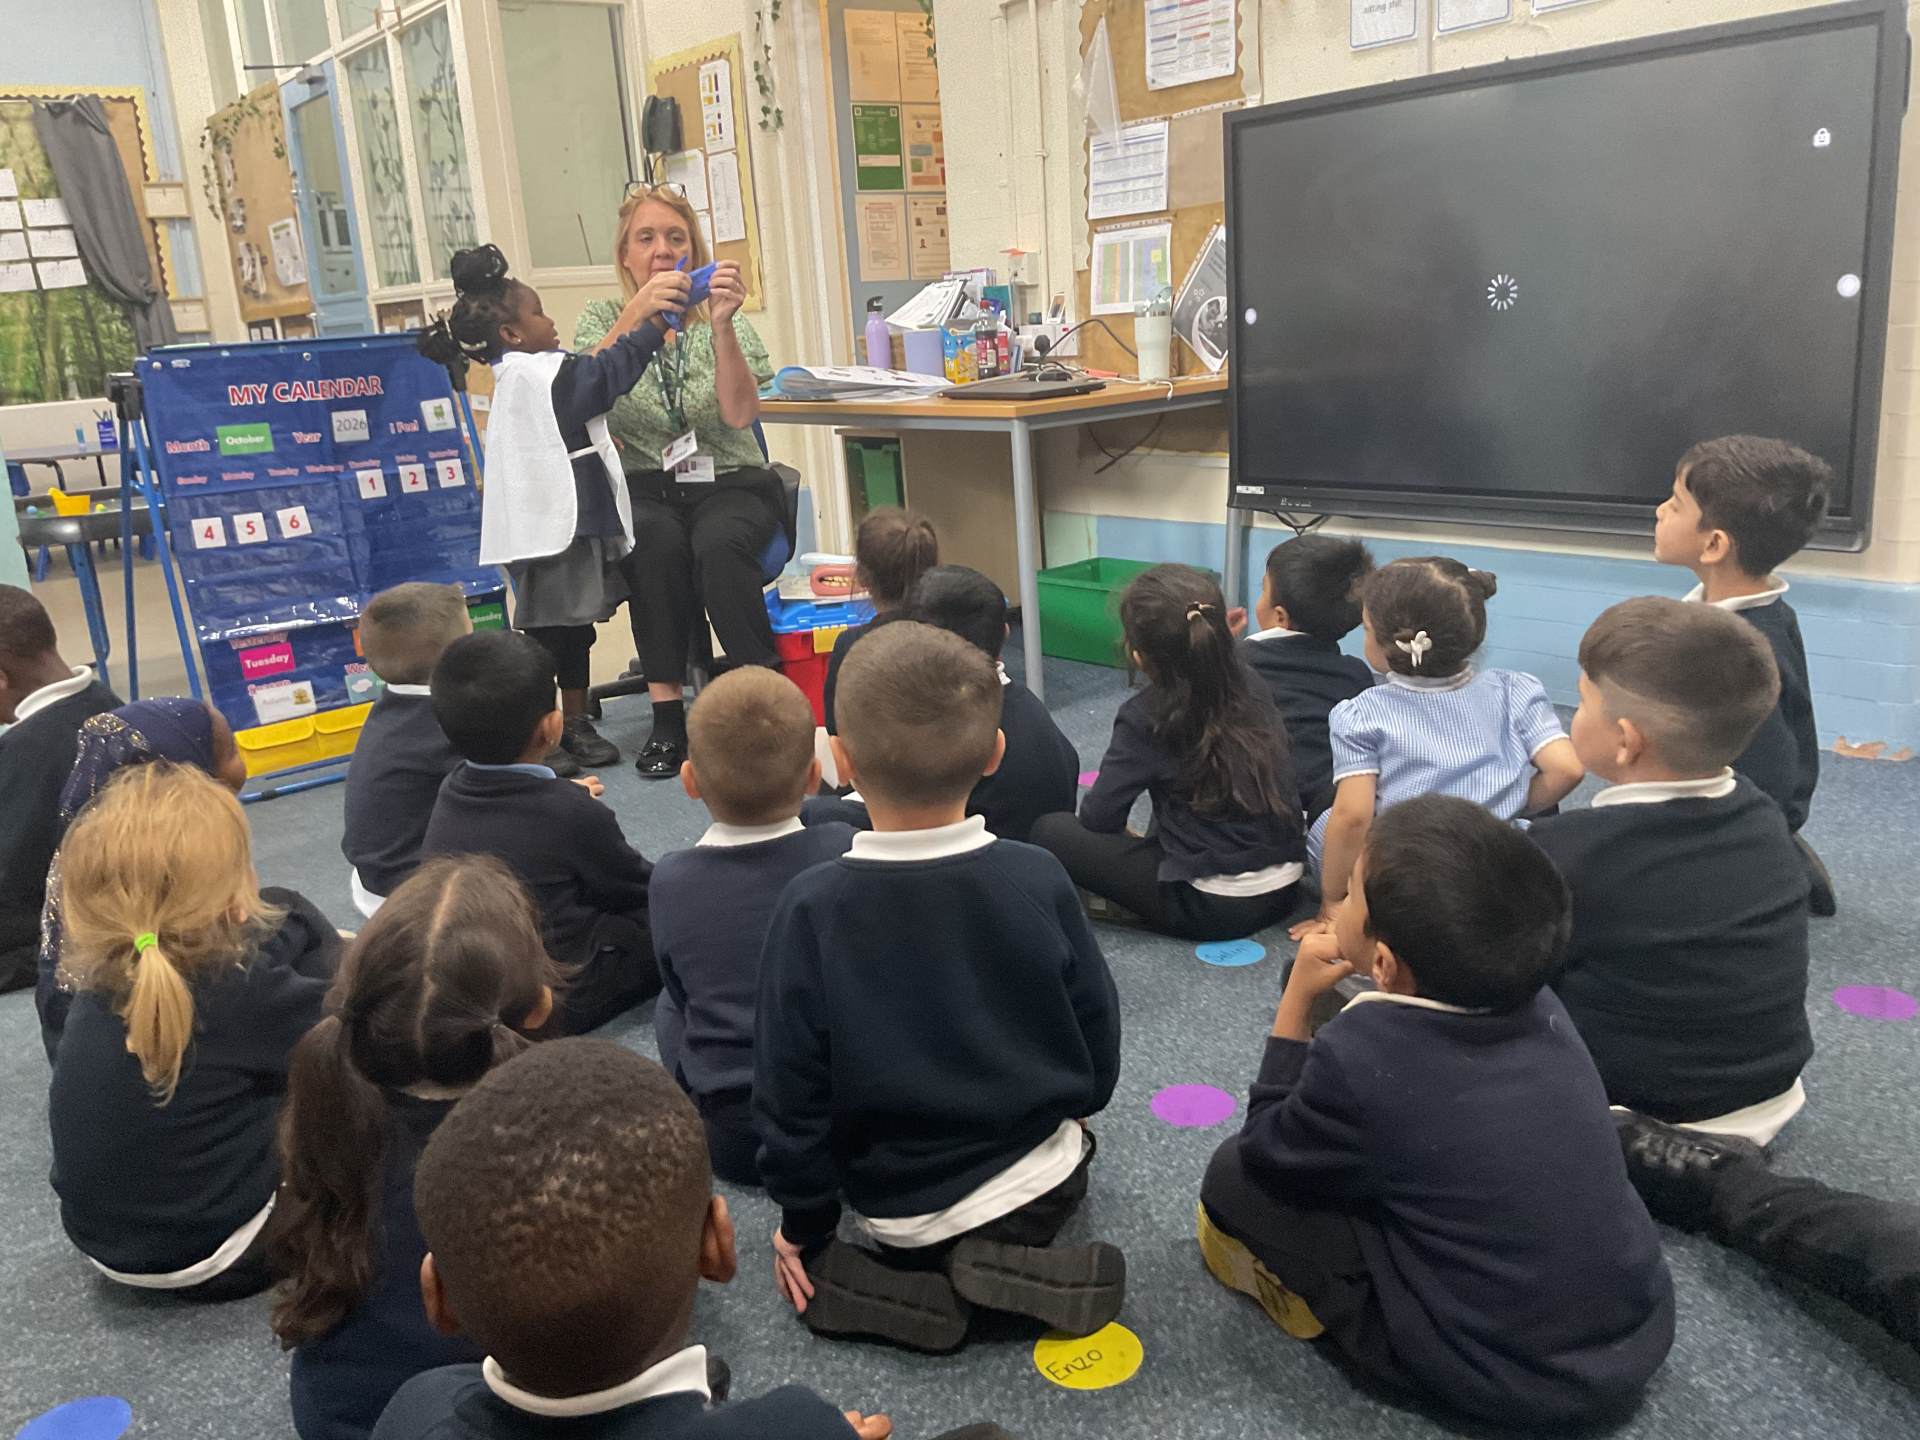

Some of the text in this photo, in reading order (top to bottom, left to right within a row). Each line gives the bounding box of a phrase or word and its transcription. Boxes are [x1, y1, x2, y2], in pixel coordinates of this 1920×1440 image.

[228, 376, 384, 405] MY CALENDAR
[225, 434, 265, 445] October
[292, 431, 322, 444] Year
[368, 467, 456, 490] 1 2 3
[204, 514, 300, 540] 4 5 6
[245, 653, 289, 669] Tuesday
[1045, 1349, 1102, 1381] Enzo
